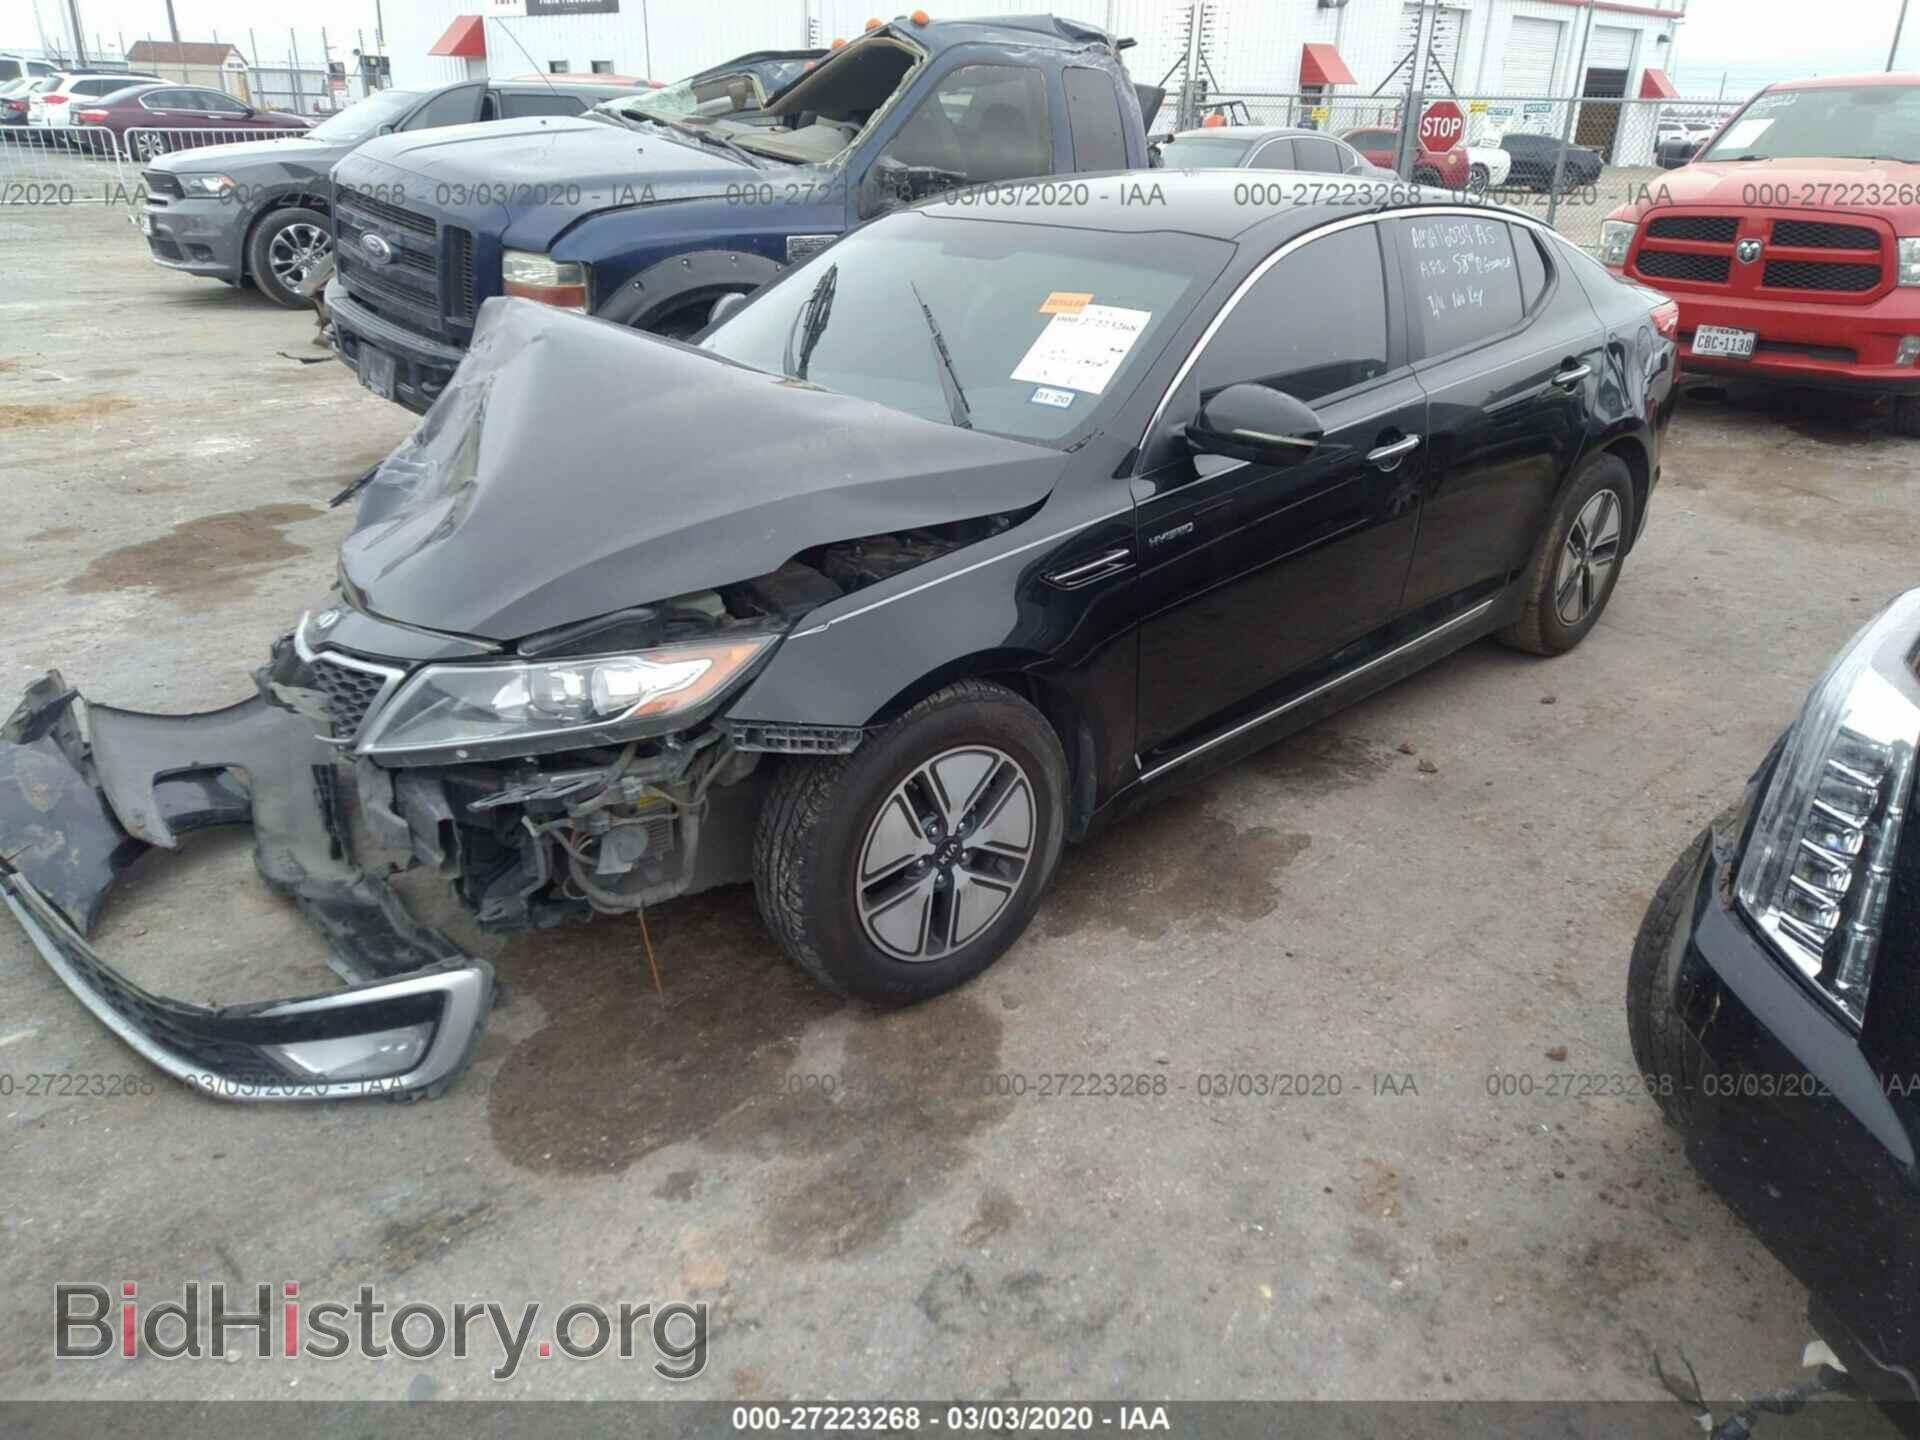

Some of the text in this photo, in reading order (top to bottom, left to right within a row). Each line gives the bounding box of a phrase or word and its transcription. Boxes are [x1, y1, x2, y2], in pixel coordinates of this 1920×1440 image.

[1421, 116, 1462, 137] STOP
[1697, 335, 1753, 353] CBC-1138
[939, 843, 958, 865] KIA
